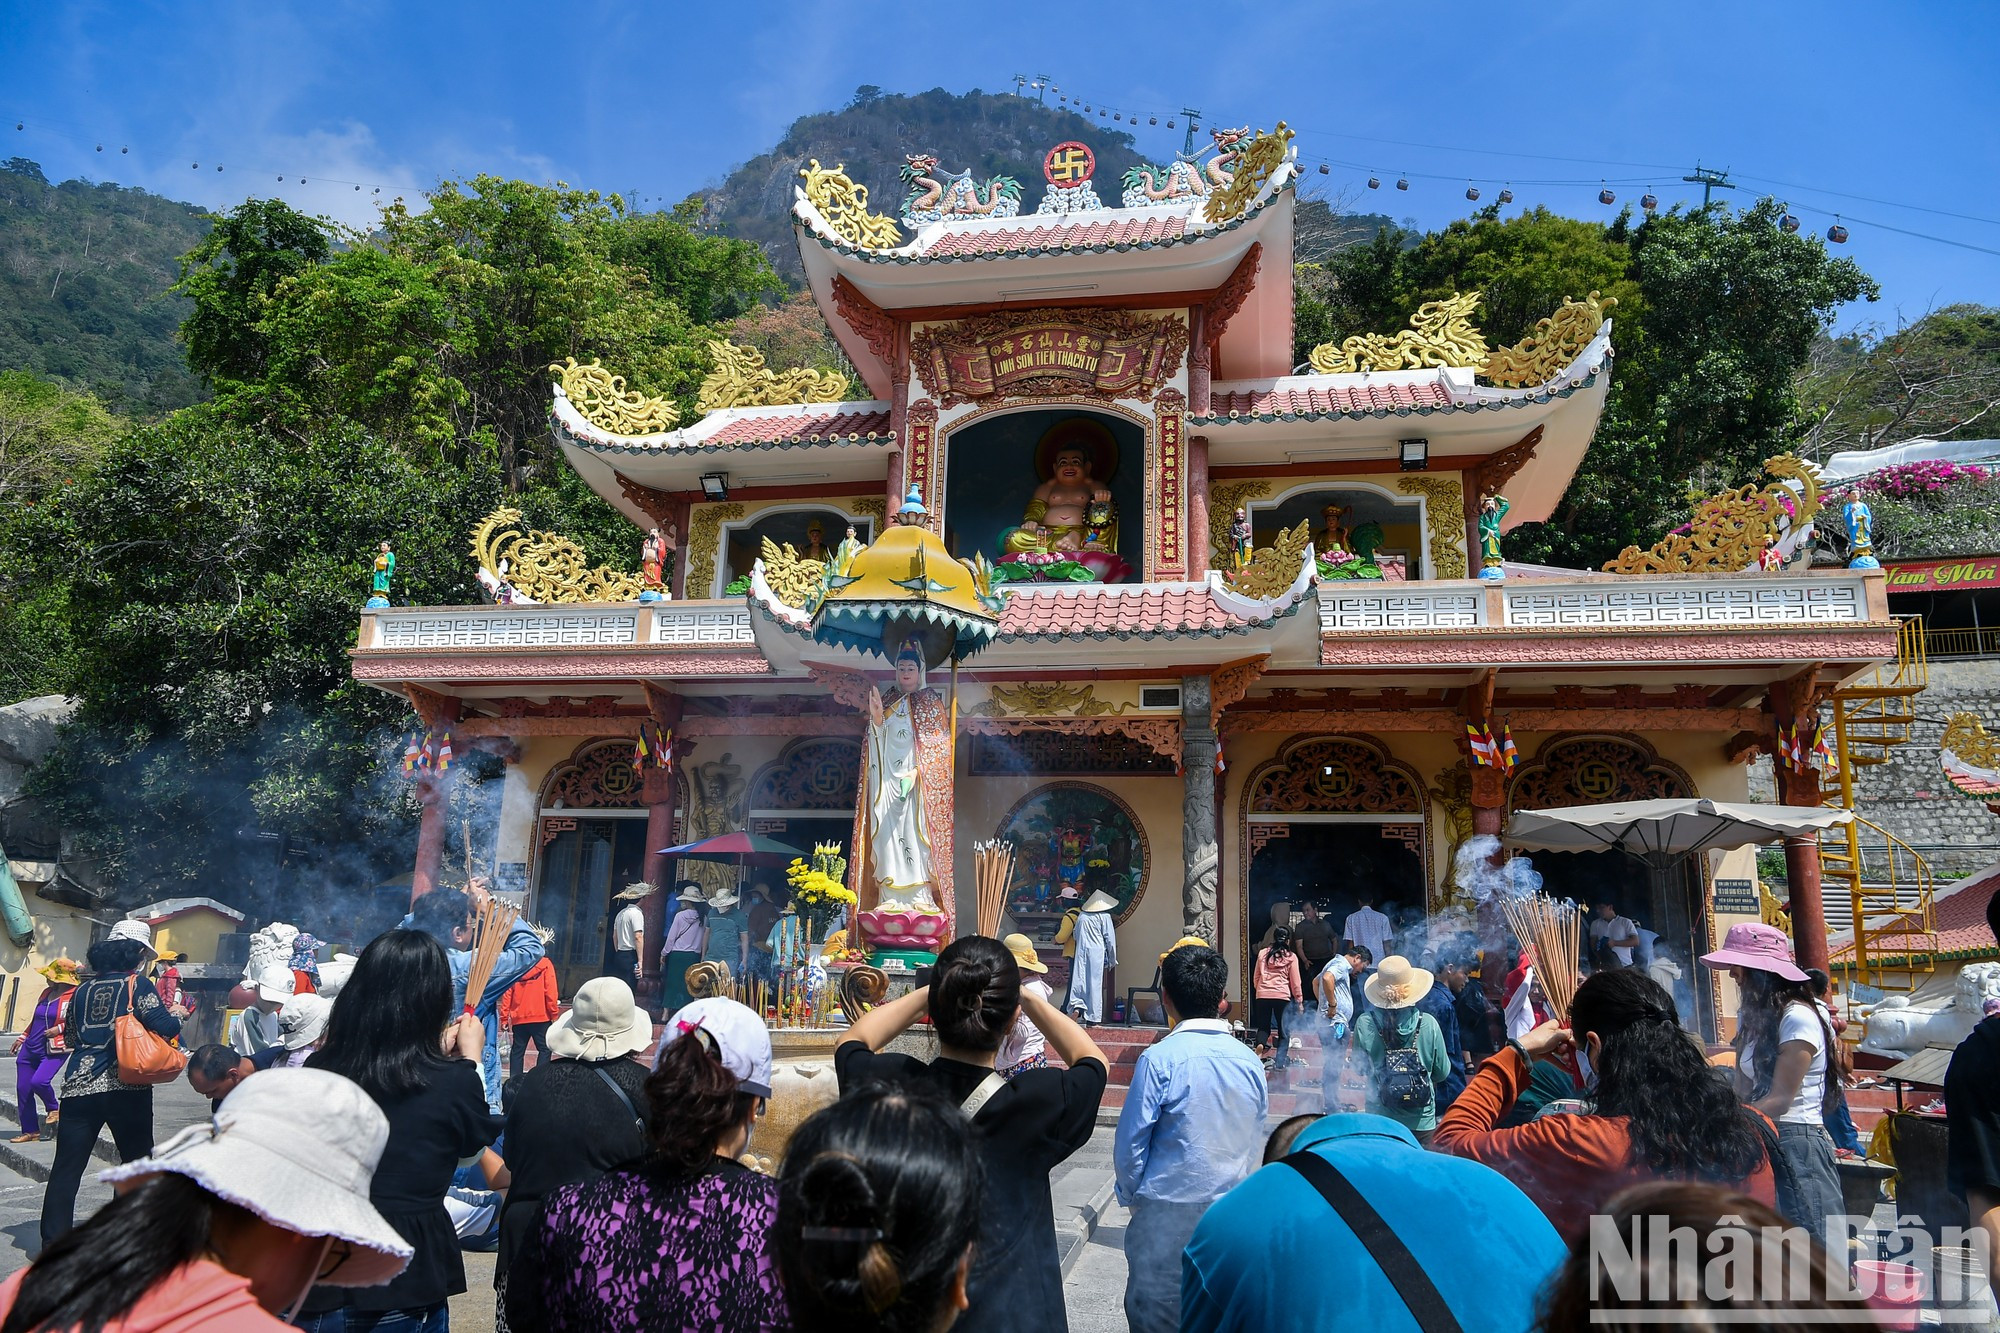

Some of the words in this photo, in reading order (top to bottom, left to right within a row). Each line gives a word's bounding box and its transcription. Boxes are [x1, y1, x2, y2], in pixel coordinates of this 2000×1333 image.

[994, 358, 1015, 377] LINH
[1016, 352, 1034, 370] SƠN
[1057, 350, 1086, 369] THẠCH
